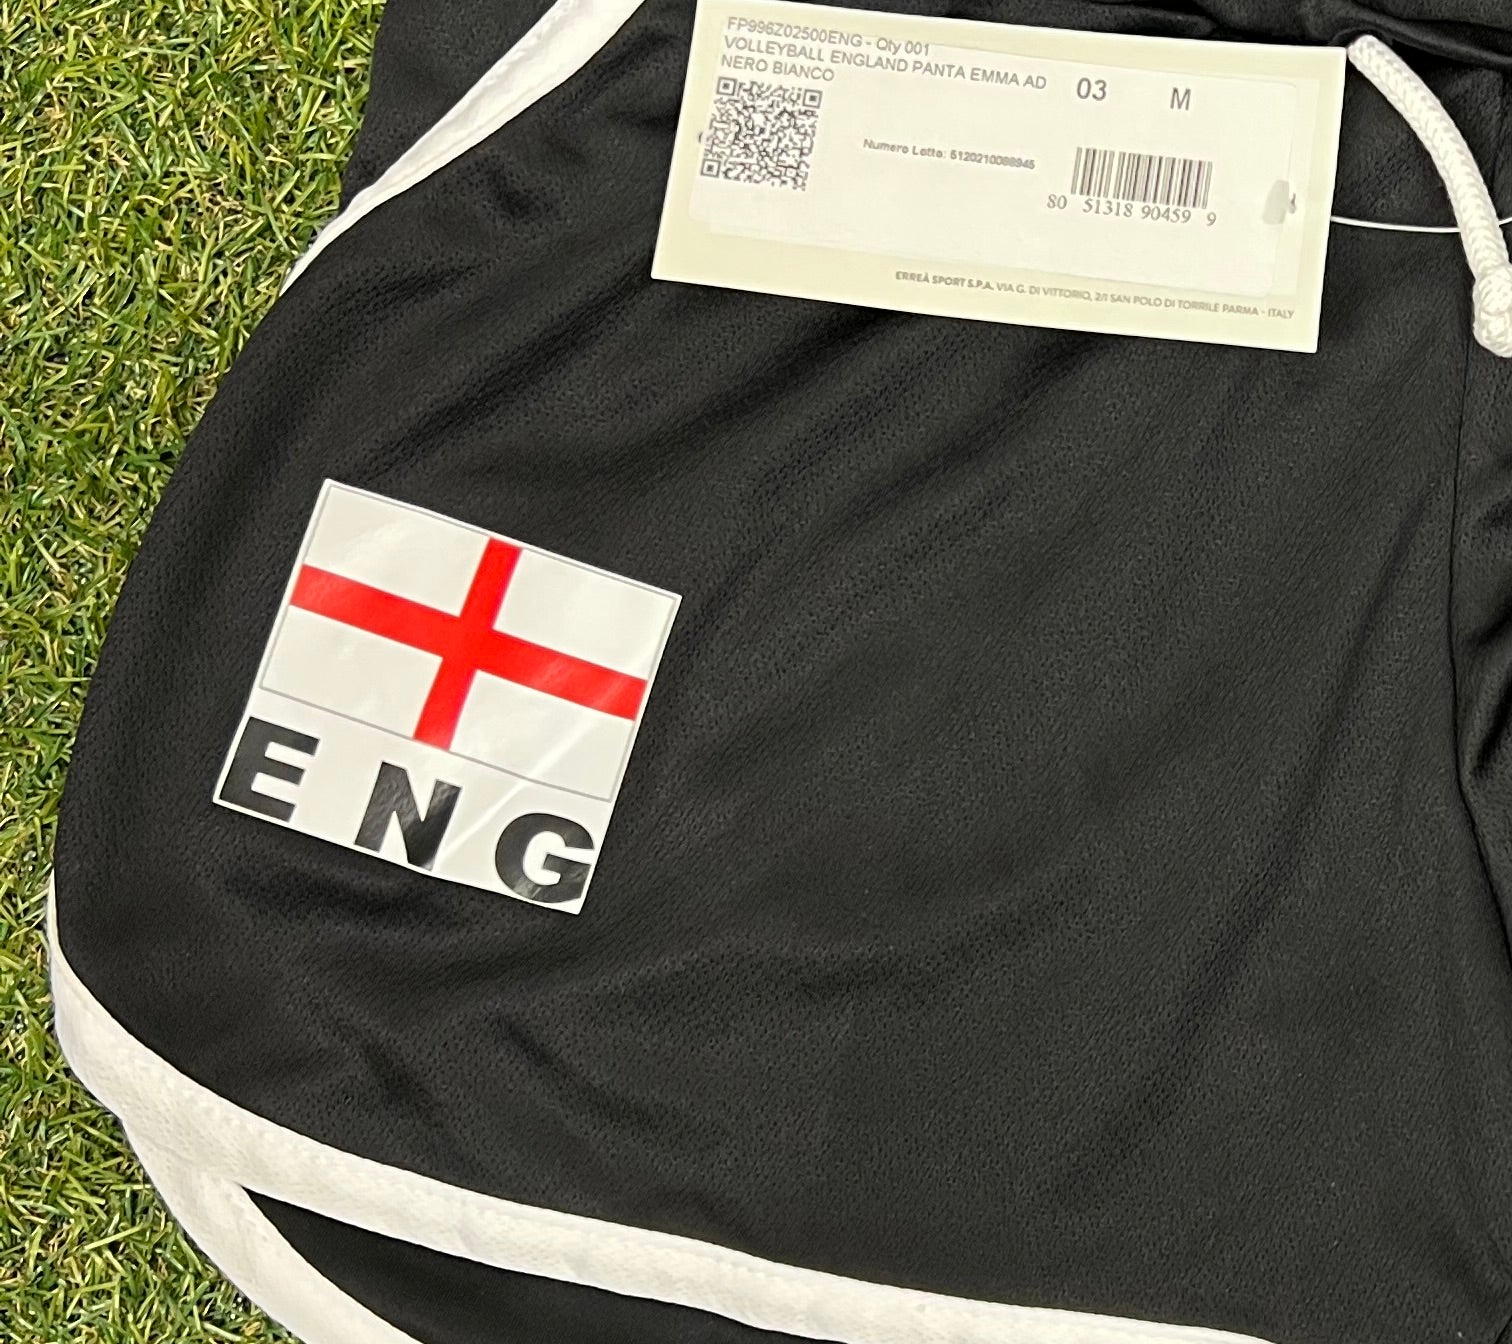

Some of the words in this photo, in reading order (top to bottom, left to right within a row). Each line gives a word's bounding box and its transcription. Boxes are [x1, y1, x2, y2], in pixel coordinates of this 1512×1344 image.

[727, 16, 862, 48] FP996Z02500ENG
[876, 37, 902, 56] Qty
[905, 40, 931, 57] 001
[720, 54, 769, 74] NERO
[772, 61, 835, 83] BIANCO
[724, 35, 826, 63] VOLLEYBALL
[830, 51, 909, 73] ENGLAND
[912, 60, 966, 80] PANTA
[970, 68, 1021, 87] EMMA
[1023, 75, 1048, 90] AD
[1076, 77, 1107, 102] 03
[1170, 87, 1192, 111] M
[863, 138, 909, 155] Numero
[1046, 194, 1068, 210] 80
[1082, 198, 1134, 218] 51318
[1141, 205, 1192, 225] 90459
[1206, 212, 1218, 226] 9
[932, 275, 966, 288] SPORT
[967, 279, 995, 291] S.P.A.
[996, 282, 1015, 293] VIA
[1028, 285, 1041, 296] DI
[1110, 293, 1131, 304] SAN
[1133, 296, 1163, 307] POLO
[1164, 299, 1176, 309] DI
[1178, 299, 1220, 313] TORRILE
[1222, 304, 1259, 316] PARMA
[1267, 308, 1295, 320] ITALY
